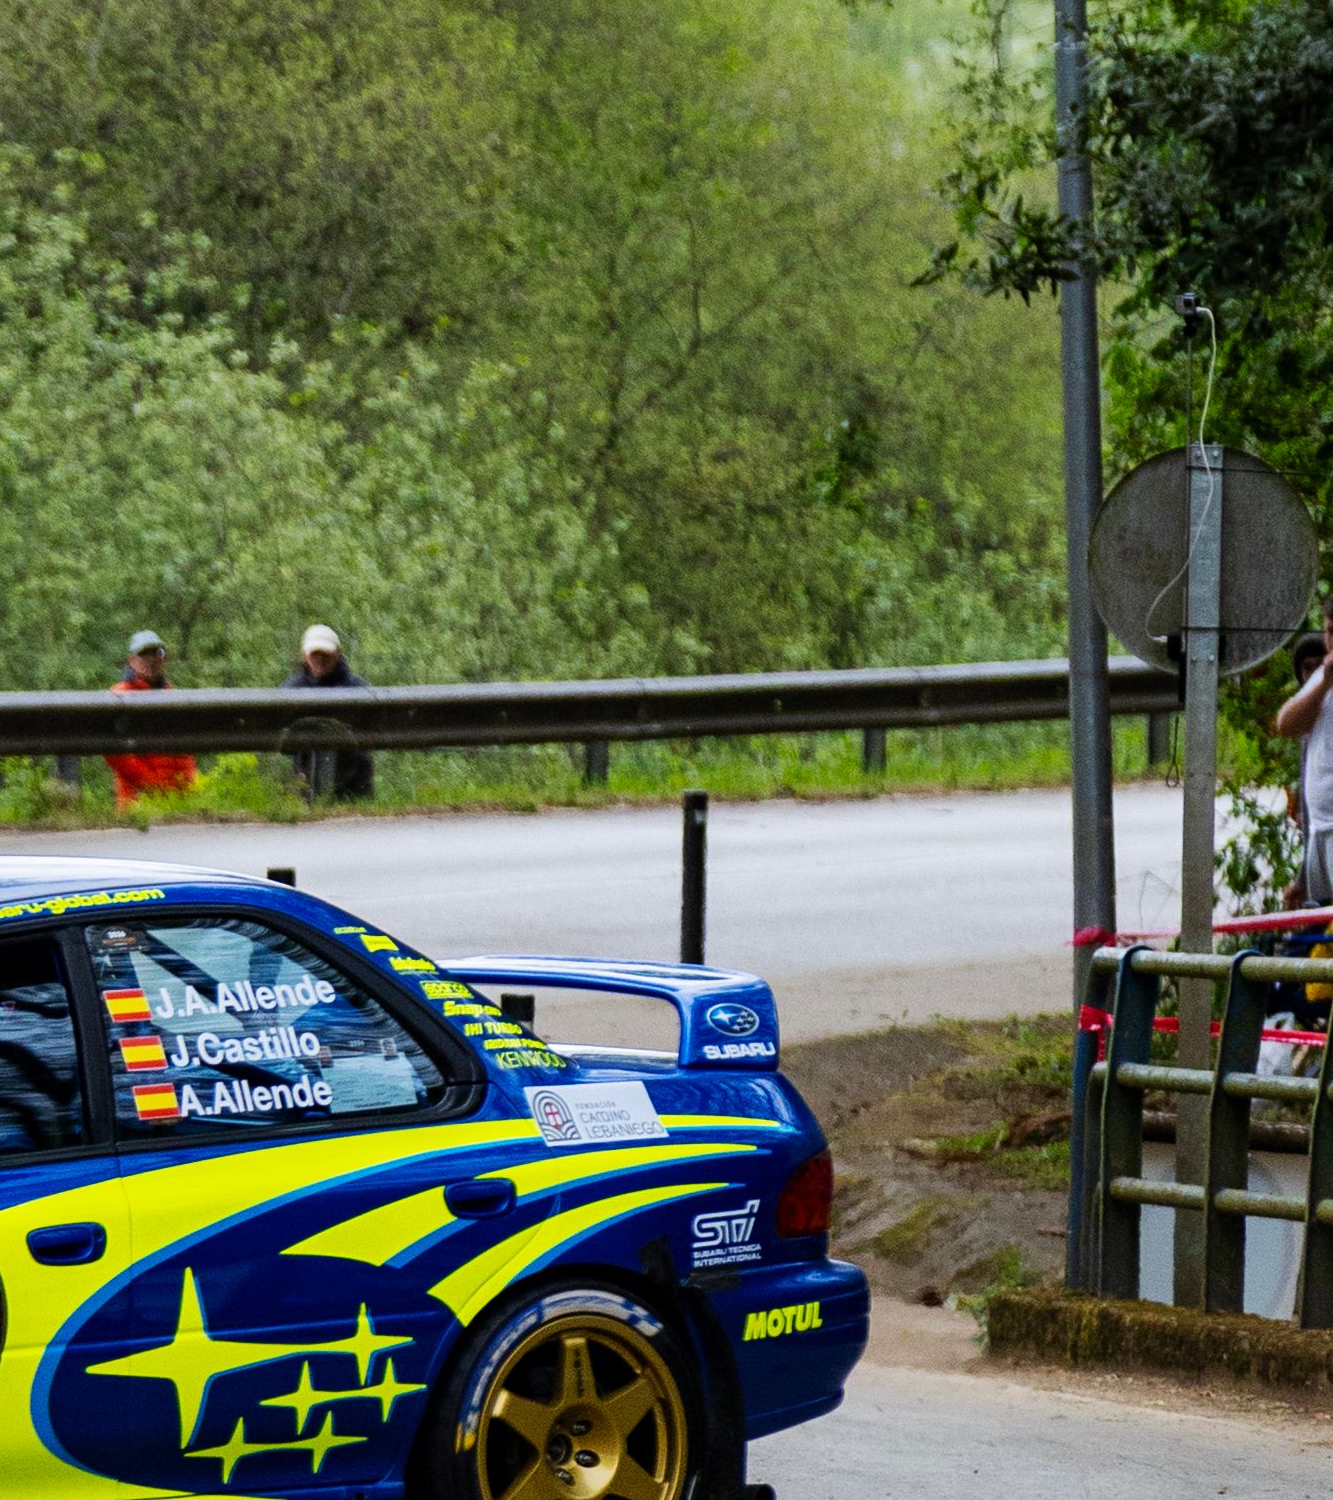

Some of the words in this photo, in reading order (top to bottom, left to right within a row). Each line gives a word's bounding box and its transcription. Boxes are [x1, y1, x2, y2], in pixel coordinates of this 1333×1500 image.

[155, 974, 336, 1019] J.A.Allende
[170, 1026, 320, 1067] J.Castillo
[703, 1041, 776, 1059] SUBARU
[496, 1051, 566, 1069] KENWOOD
[181, 1074, 333, 1117] A.Allende
[580, 1109, 631, 1124] CAMINO
[584, 1120, 665, 1139] LEBANIEGO
[693, 1247, 728, 1259] SUBARU
[693, 1252, 762, 1268] INTERNATIONAL
[742, 1301, 823, 1341] MOTUL
